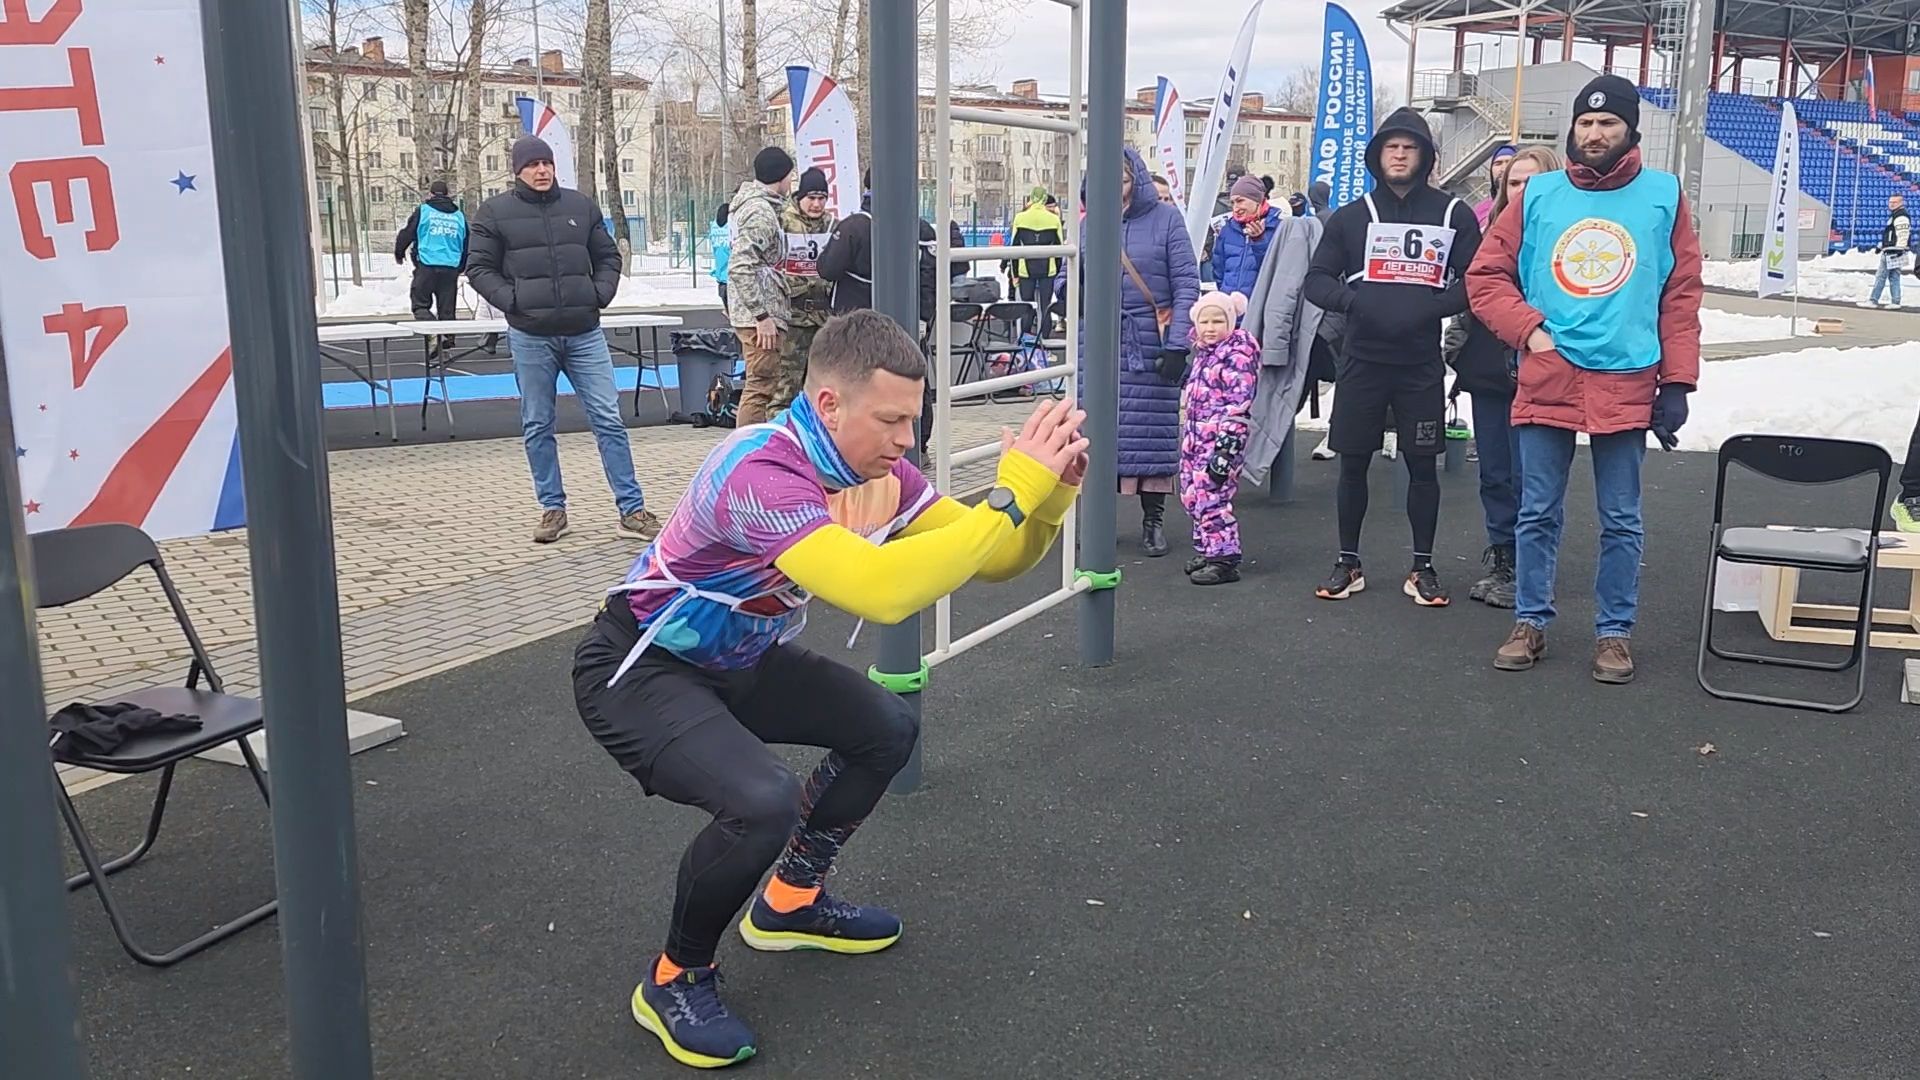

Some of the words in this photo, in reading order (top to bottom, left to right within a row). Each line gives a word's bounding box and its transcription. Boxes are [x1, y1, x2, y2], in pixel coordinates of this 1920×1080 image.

[1324, 31, 1344, 130] РОССИИ
[1344, 38, 1355, 123] ОТДЕЛЕНИЕ
[1356, 70, 1366, 136] ОБЛАСТИ
[808, 240, 819, 260] 3
[1404, 229, 1423, 259] 6
